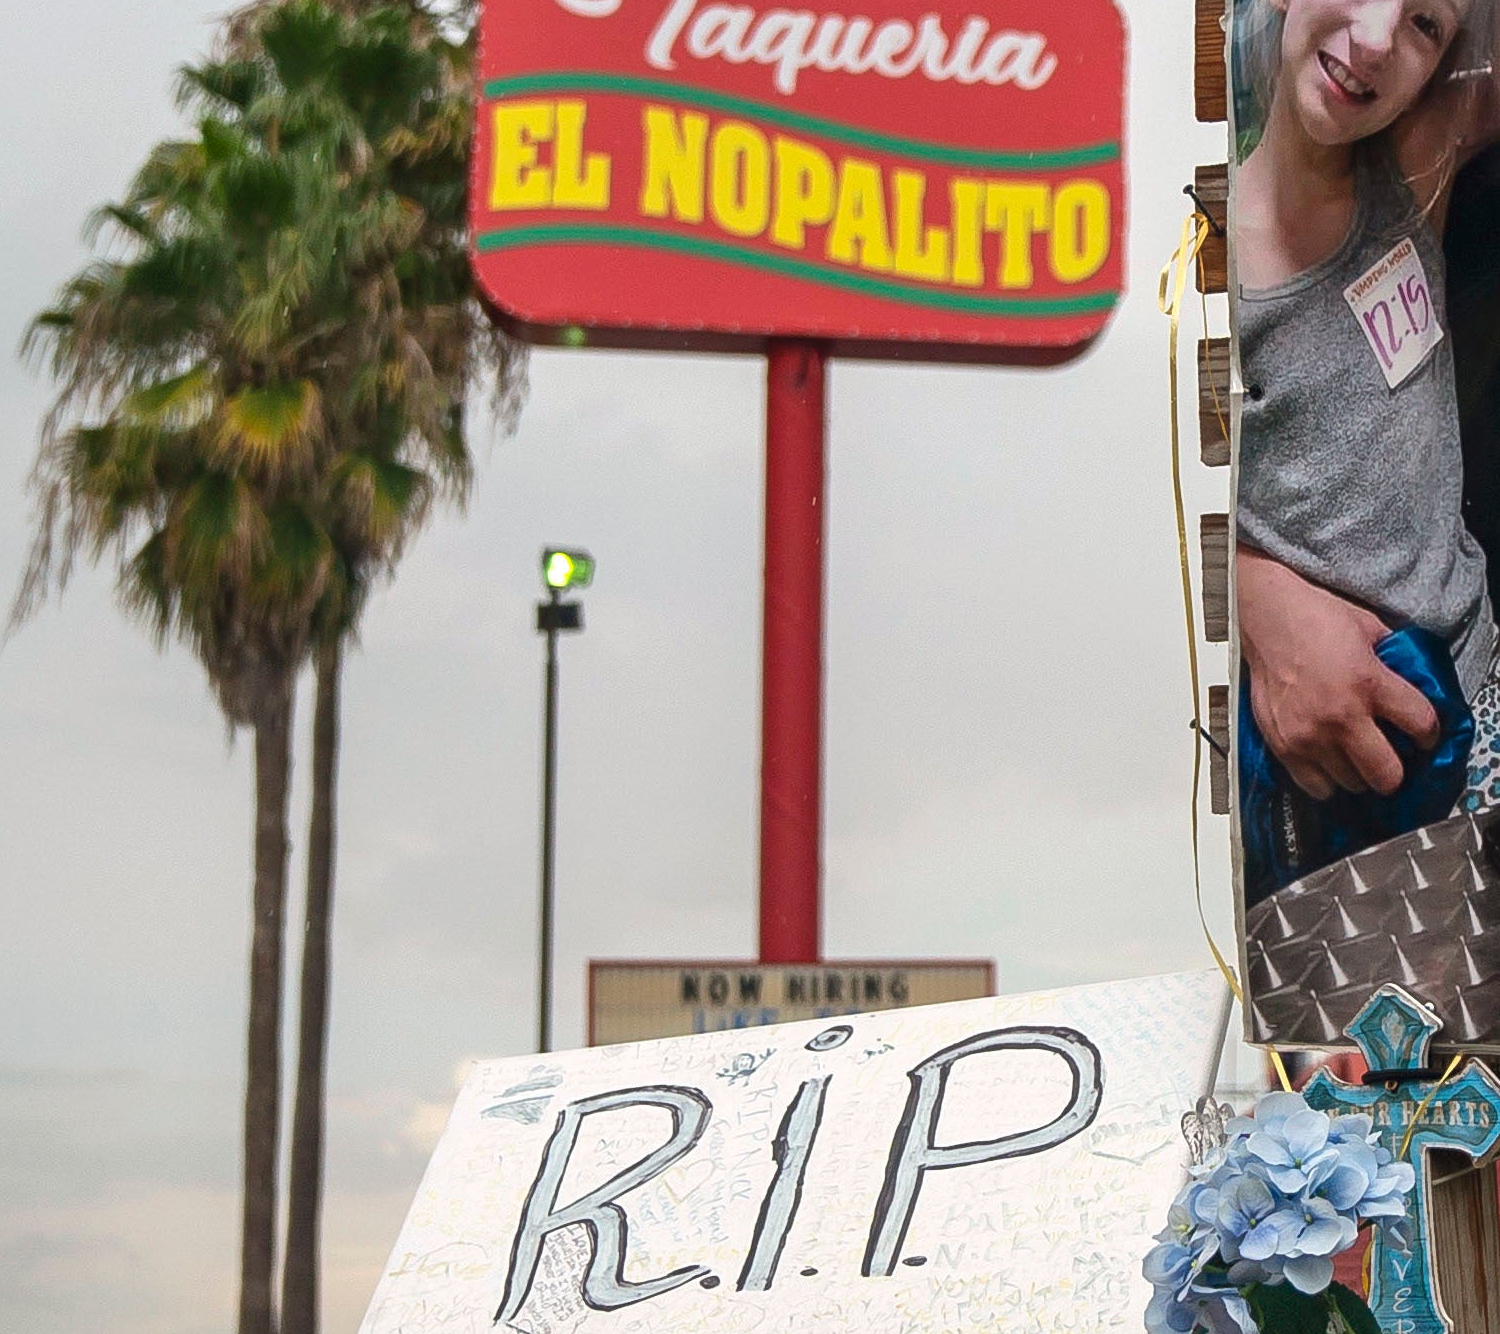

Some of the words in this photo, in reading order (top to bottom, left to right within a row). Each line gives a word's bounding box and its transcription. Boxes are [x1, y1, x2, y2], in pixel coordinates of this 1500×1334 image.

[488, 100, 610, 212] EL
[640, 105, 1112, 291] NOPALITO
[1362, 274, 1429, 369] 12:15
[680, 973, 763, 1005] NOW
[783, 973, 910, 1005] HIRING
[1401, 1100, 1491, 1128] HEARTS
